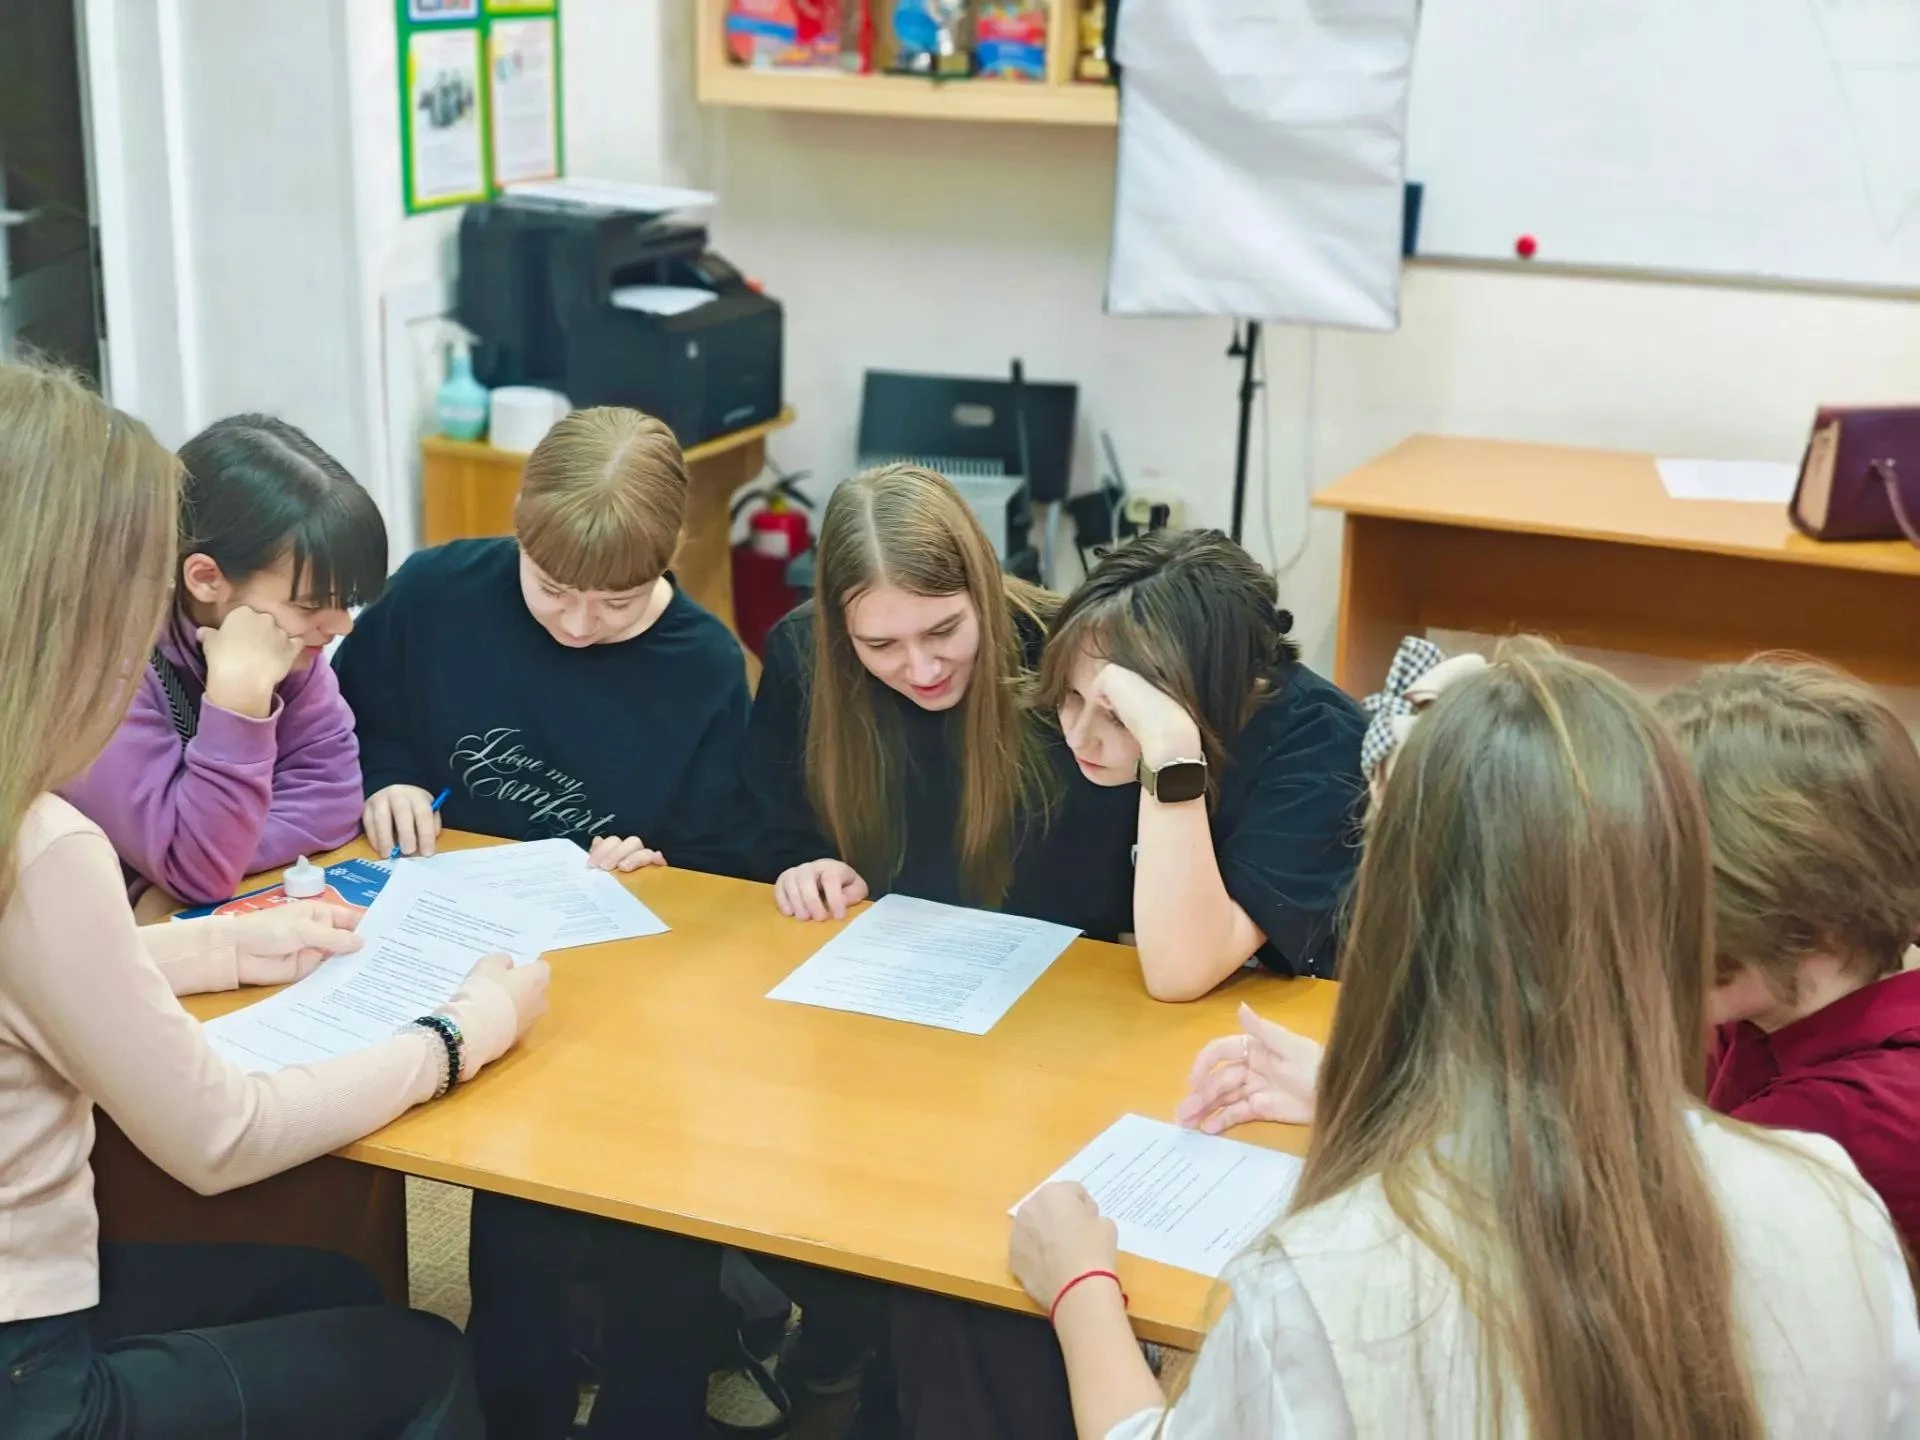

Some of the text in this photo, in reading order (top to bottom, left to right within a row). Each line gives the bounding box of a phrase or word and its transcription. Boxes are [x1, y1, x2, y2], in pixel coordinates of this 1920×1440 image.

[450, 727, 585, 796] I love my
[463, 762, 616, 836] Comfort
